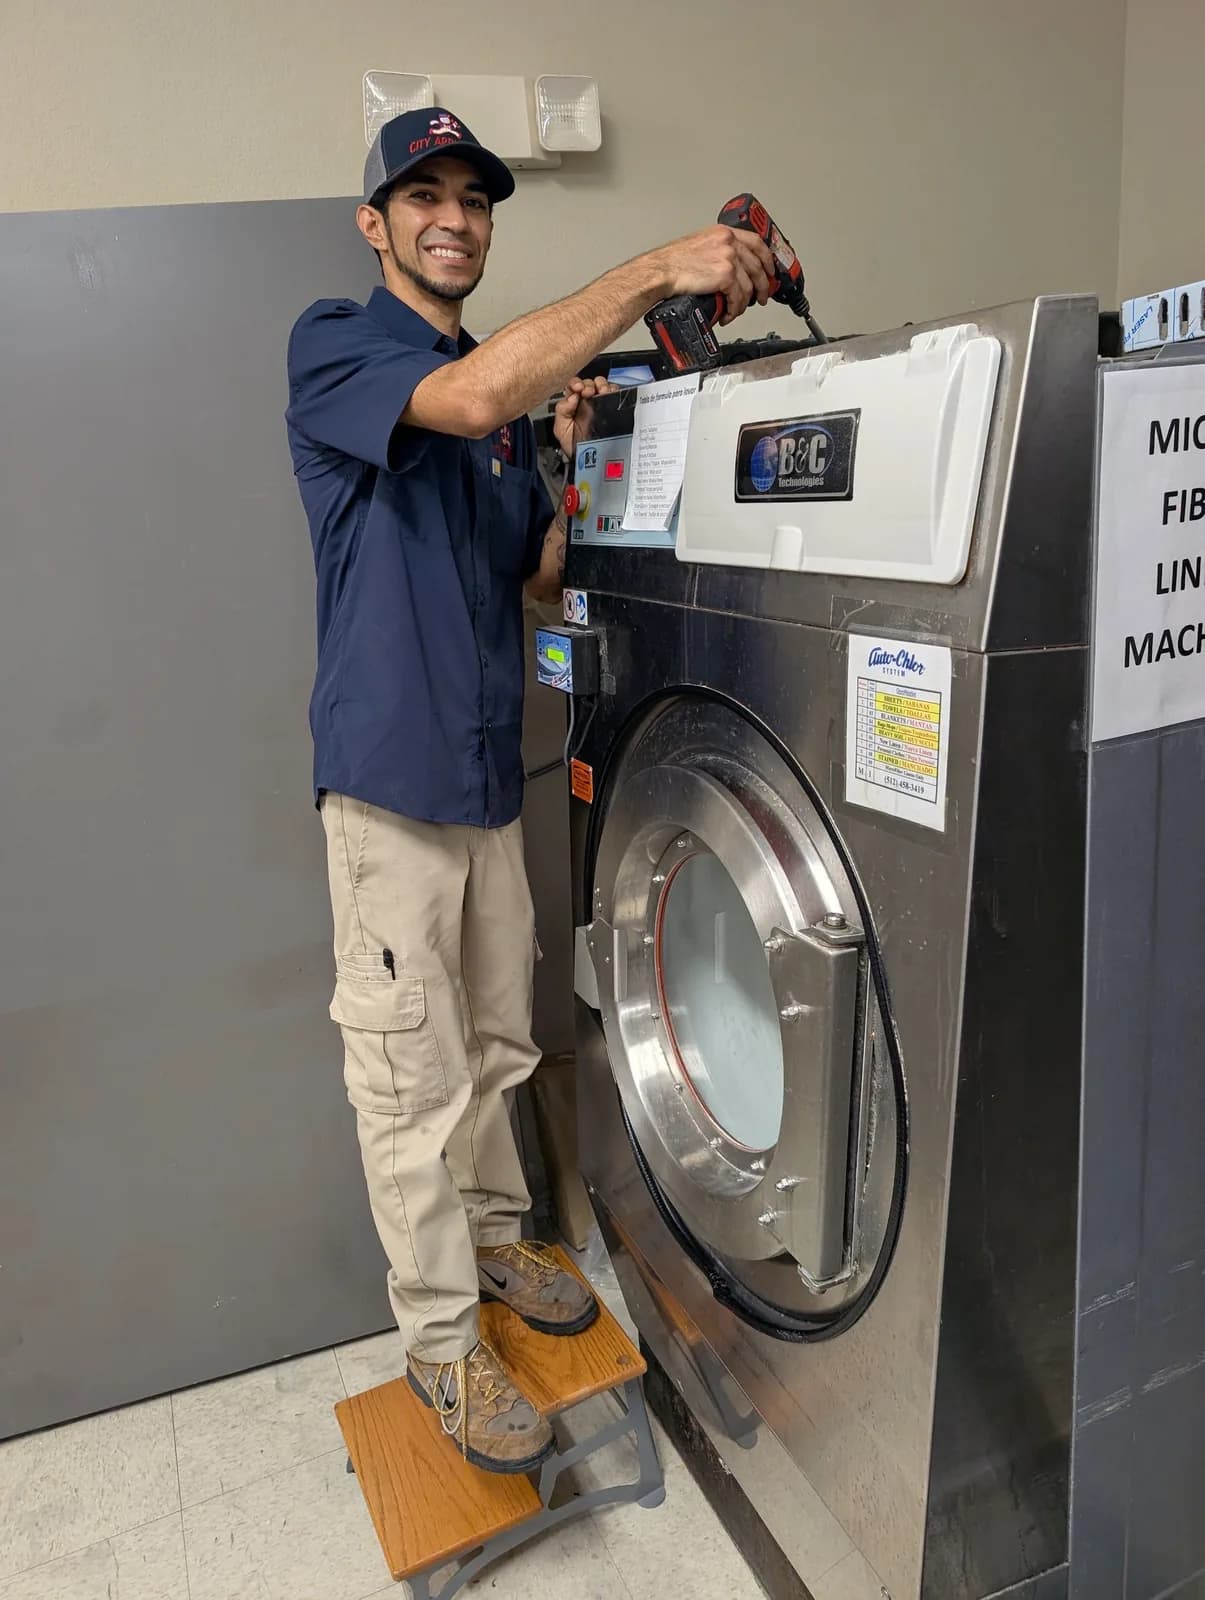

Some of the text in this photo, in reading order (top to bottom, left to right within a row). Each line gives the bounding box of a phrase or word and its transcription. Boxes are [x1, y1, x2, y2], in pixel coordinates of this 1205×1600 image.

[409, 136, 432, 153] CITY
[778, 433, 827, 476] B&C
[778, 475, 825, 488] Technologies
[1162, 487, 1205, 526] FIB
[1156, 556, 1205, 596] LIN
[868, 646, 924, 676] Auto-Chlor
[882, 667, 906, 677] SYSTEM
[883, 695, 903, 704] SHEETS
[881, 712, 906, 724] BLANKETS
[909, 718, 933, 730] MANTAS
[906, 708, 931, 720] TOALLAS
[878, 728, 894, 737] HEAVY
[858, 767, 864, 775] M
[878, 754, 899, 765] STAINED
[902, 760, 933, 773] MANCHADO
[884, 776, 925, 794] (512) 458-3419
